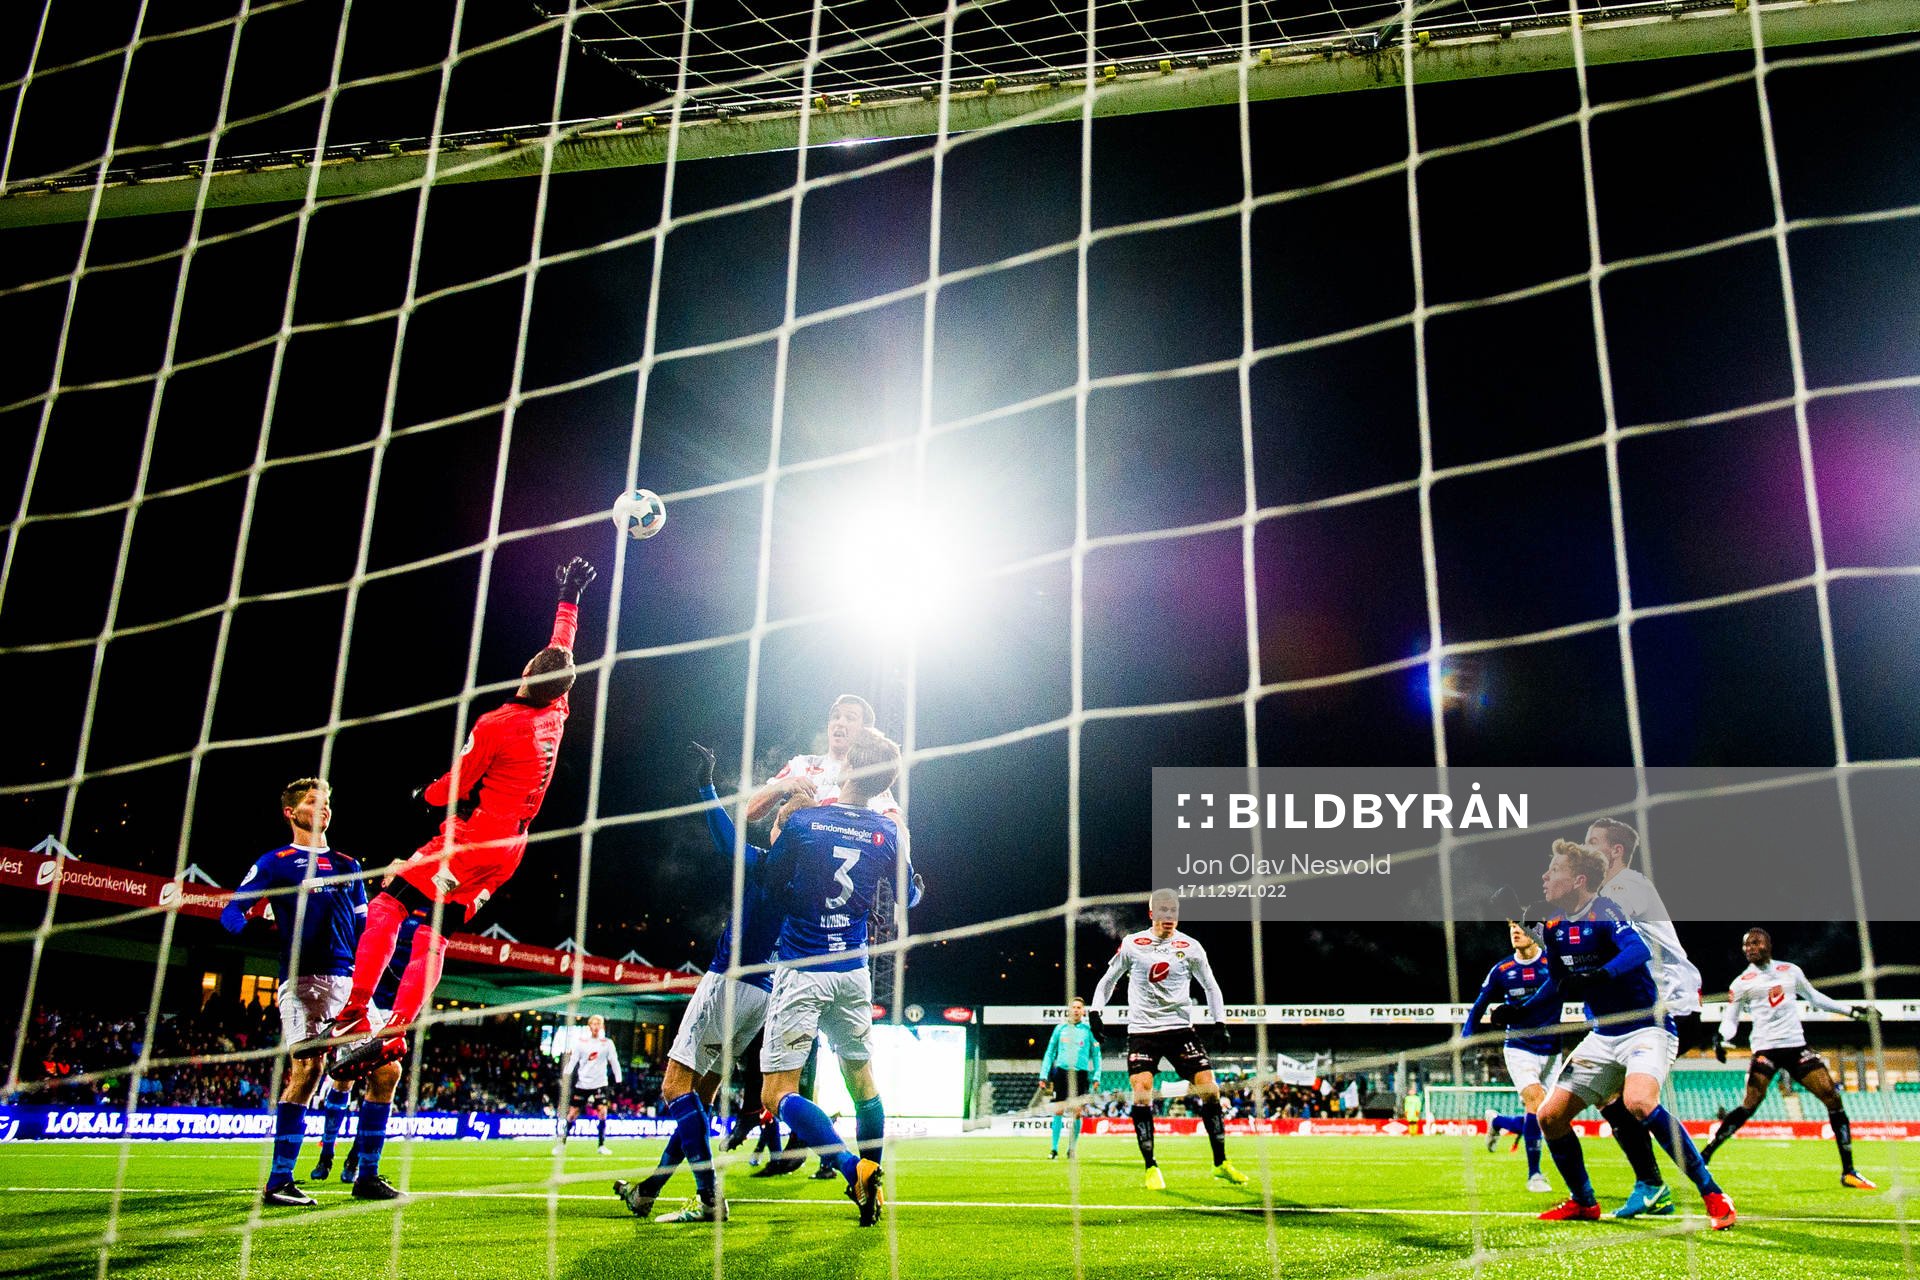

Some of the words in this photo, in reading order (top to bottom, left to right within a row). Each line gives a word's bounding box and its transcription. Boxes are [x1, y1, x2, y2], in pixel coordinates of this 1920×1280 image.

[825, 845, 862, 910] 3
[1282, 1008, 1345, 1017] FRYDENBO
[1370, 1008, 1435, 1017] FRYDENBO
[46, 1112, 123, 1133] LOKAL
[127, 1113, 277, 1134] ELEKTROKOMP
